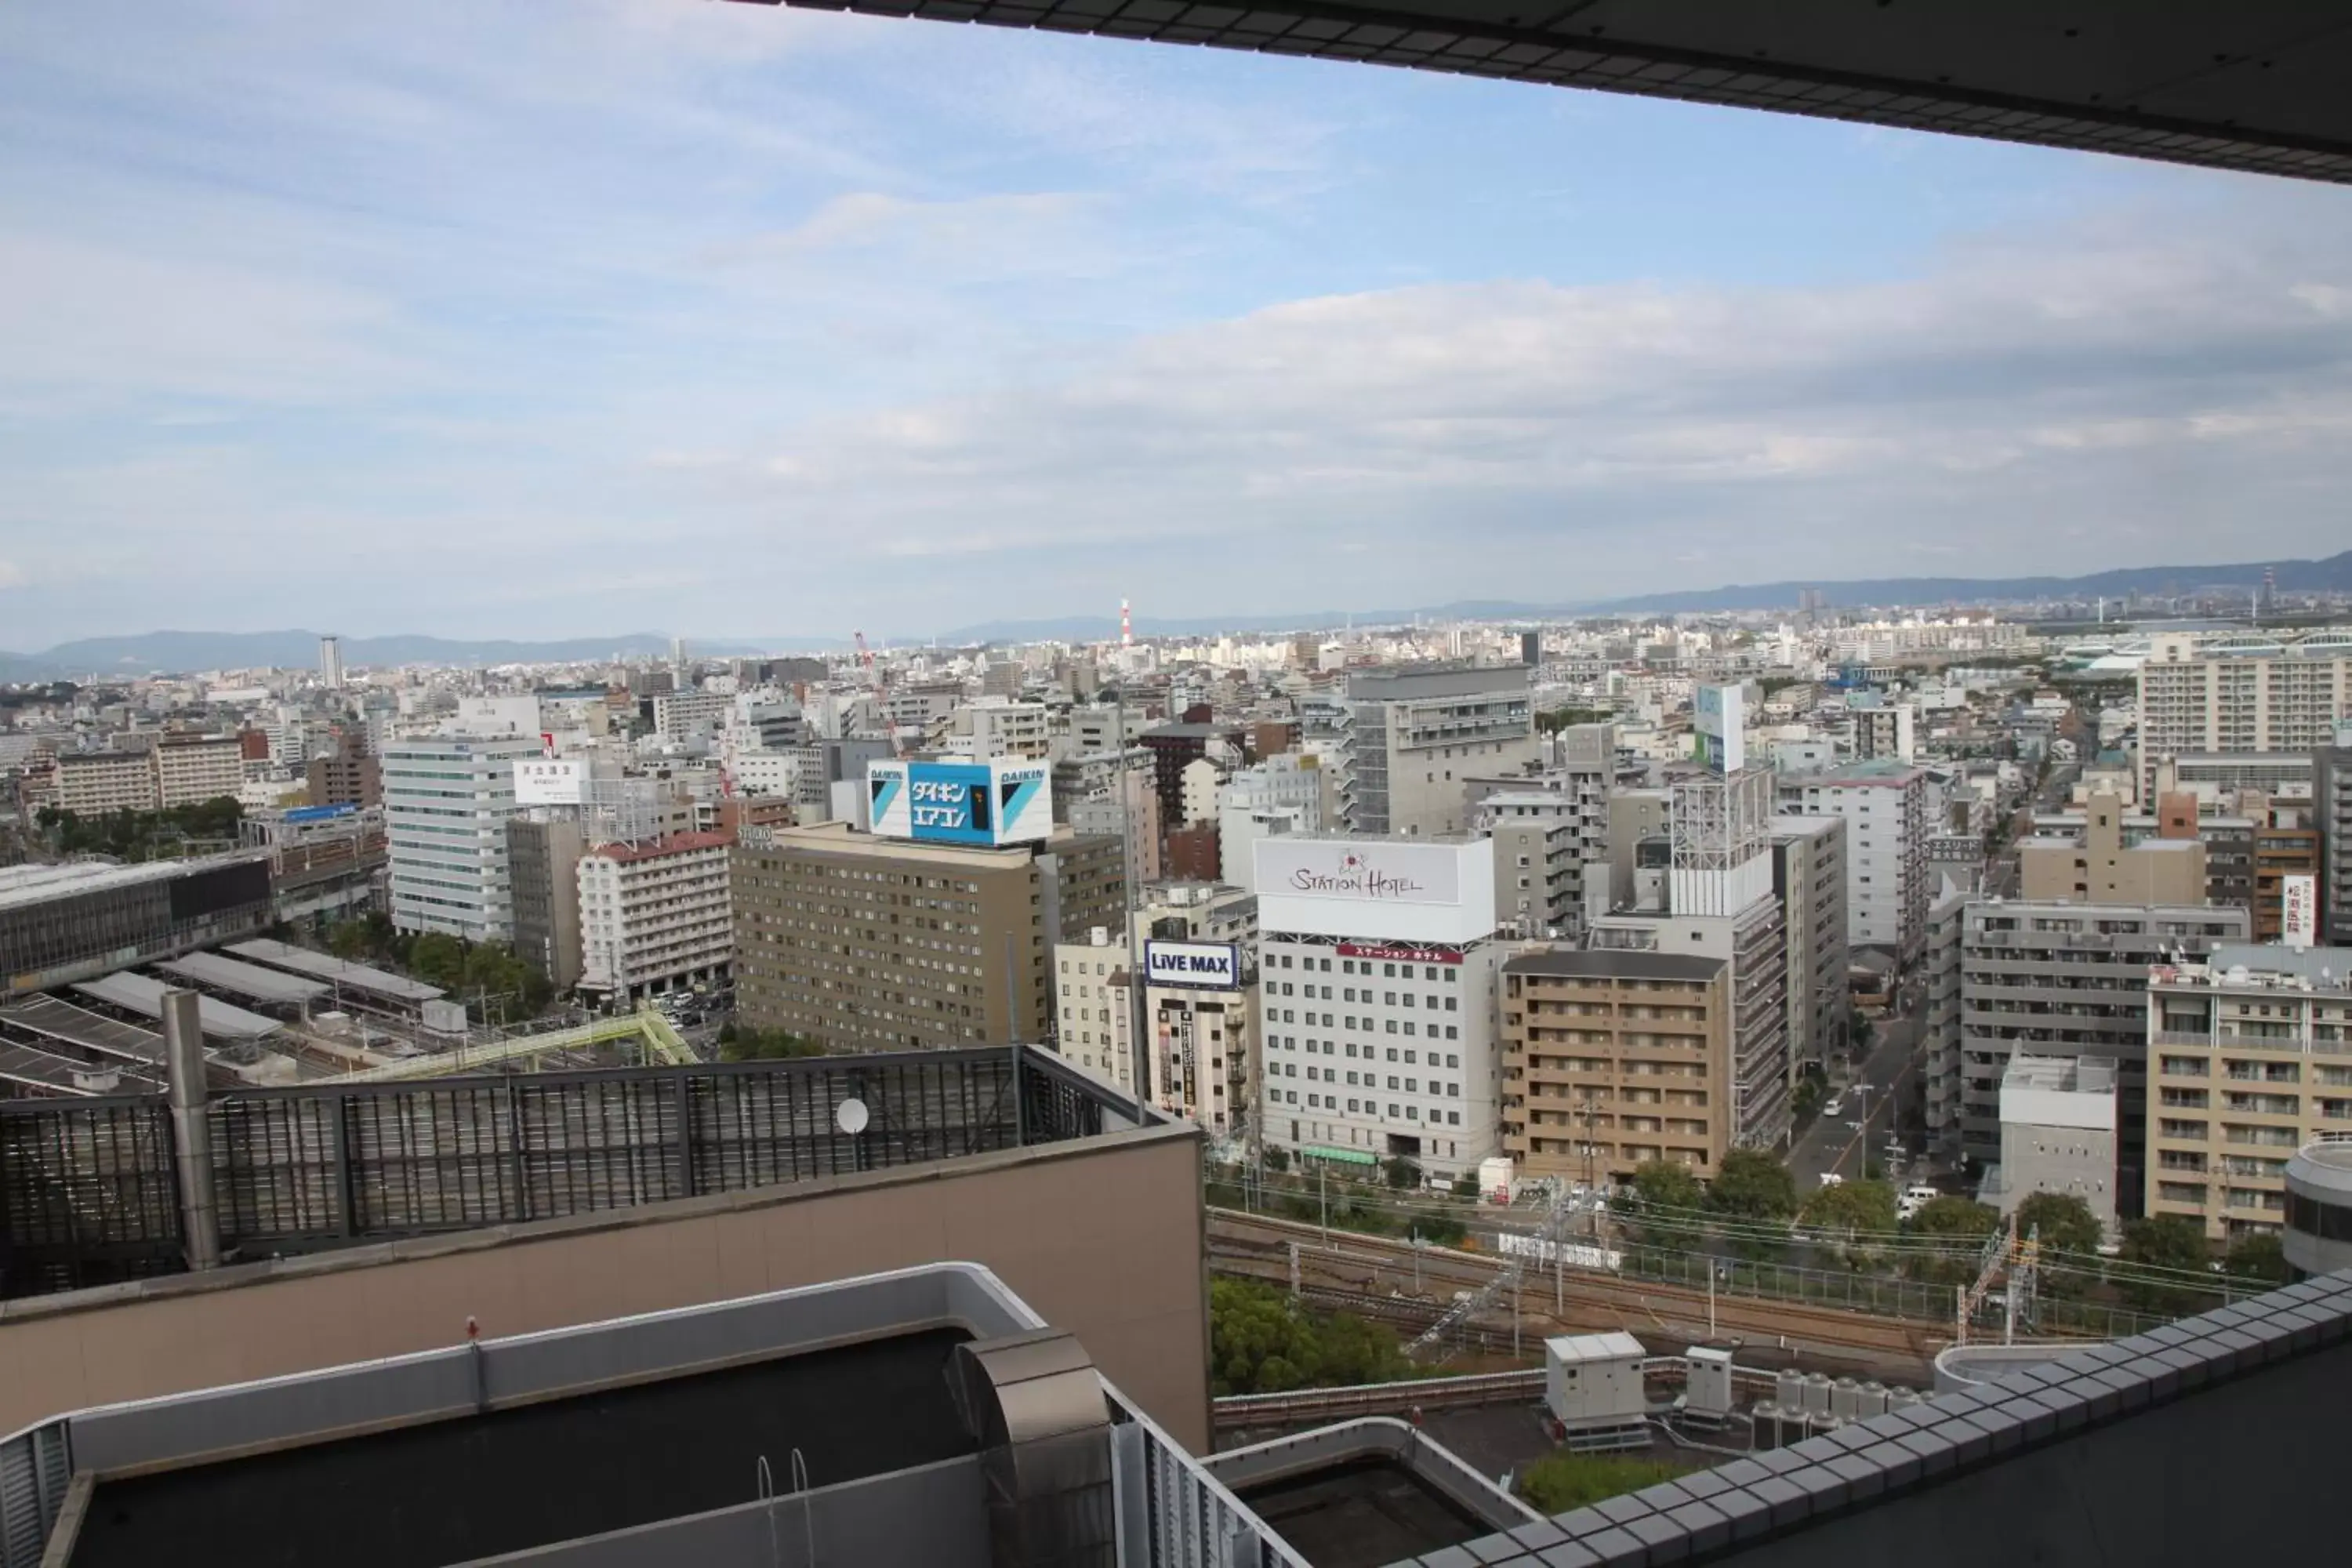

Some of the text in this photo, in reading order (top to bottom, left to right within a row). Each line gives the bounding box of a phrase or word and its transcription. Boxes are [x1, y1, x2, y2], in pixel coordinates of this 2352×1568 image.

[870, 768, 903, 779] DAIKIN
[1001, 769, 1045, 782] DAIKIN
[912, 781, 965, 802] ダイキン
[913, 806, 966, 828] エアコン
[1290, 868, 1425, 897] STATION HOTEL
[1355, 947, 1442, 961] ステーション ホテル
[1190, 956, 1229, 974] MAX
